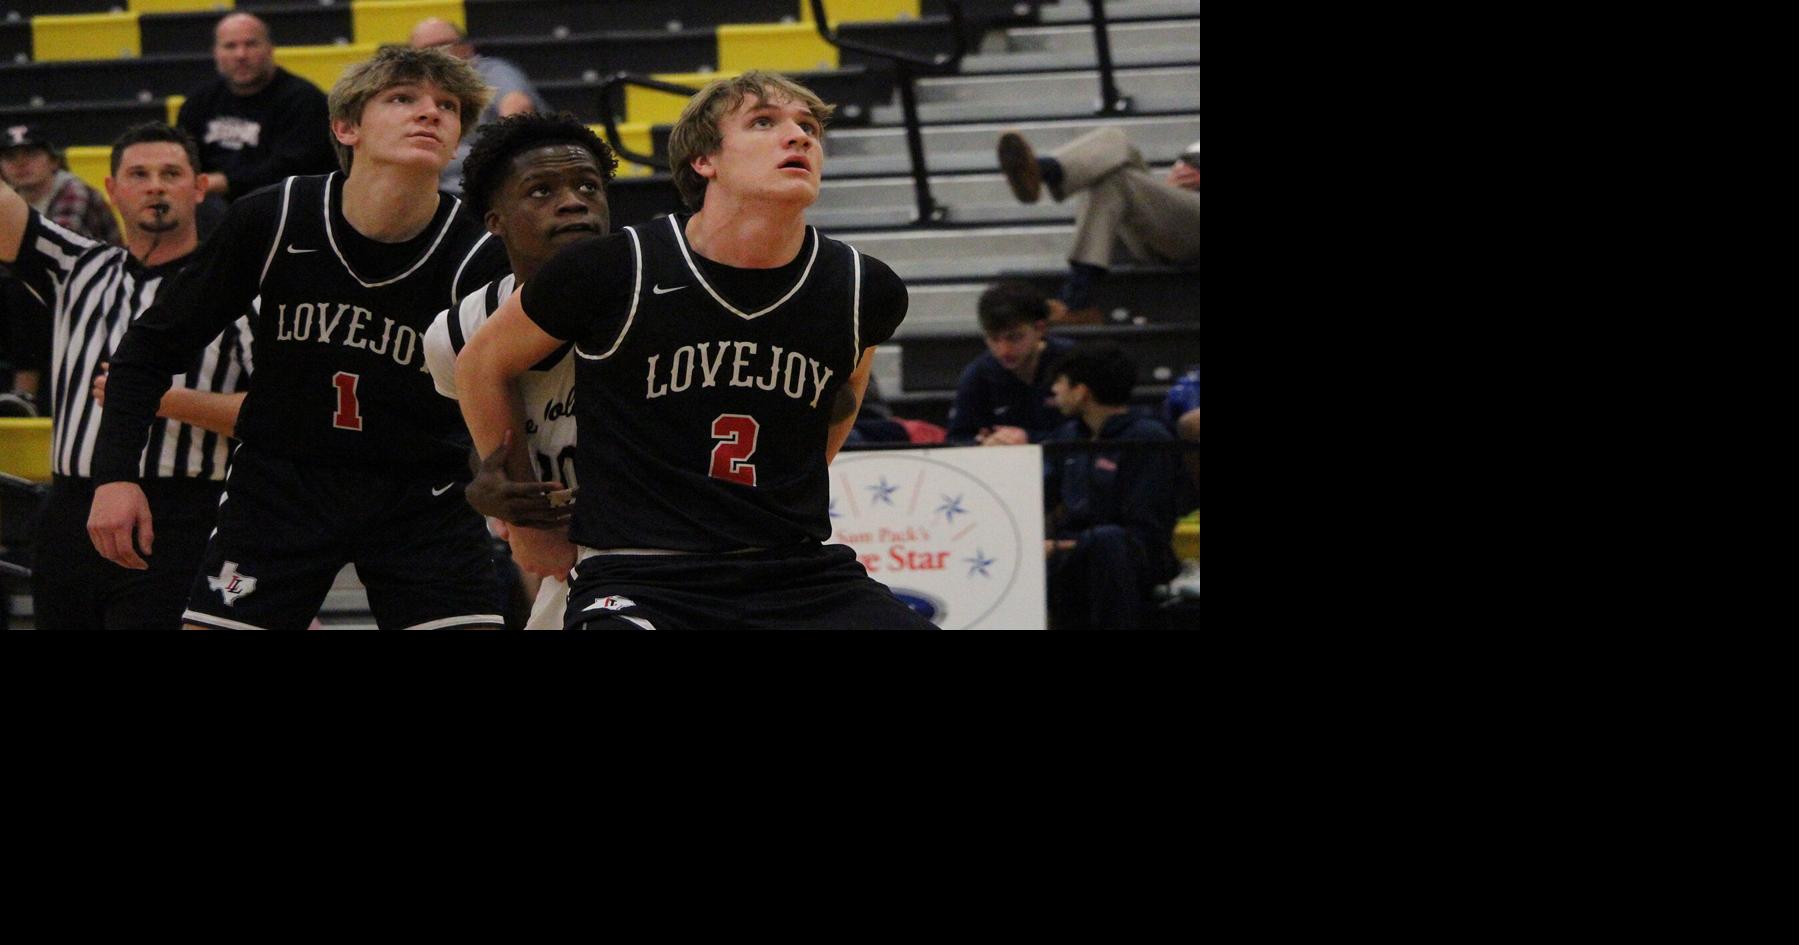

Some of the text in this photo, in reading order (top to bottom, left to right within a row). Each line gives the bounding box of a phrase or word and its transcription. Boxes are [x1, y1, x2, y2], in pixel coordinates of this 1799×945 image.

[332, 370, 363, 432] 1
[646, 341, 834, 409] LOVEJOY
[708, 413, 760, 487] 2
[888, 545, 951, 573] Star
